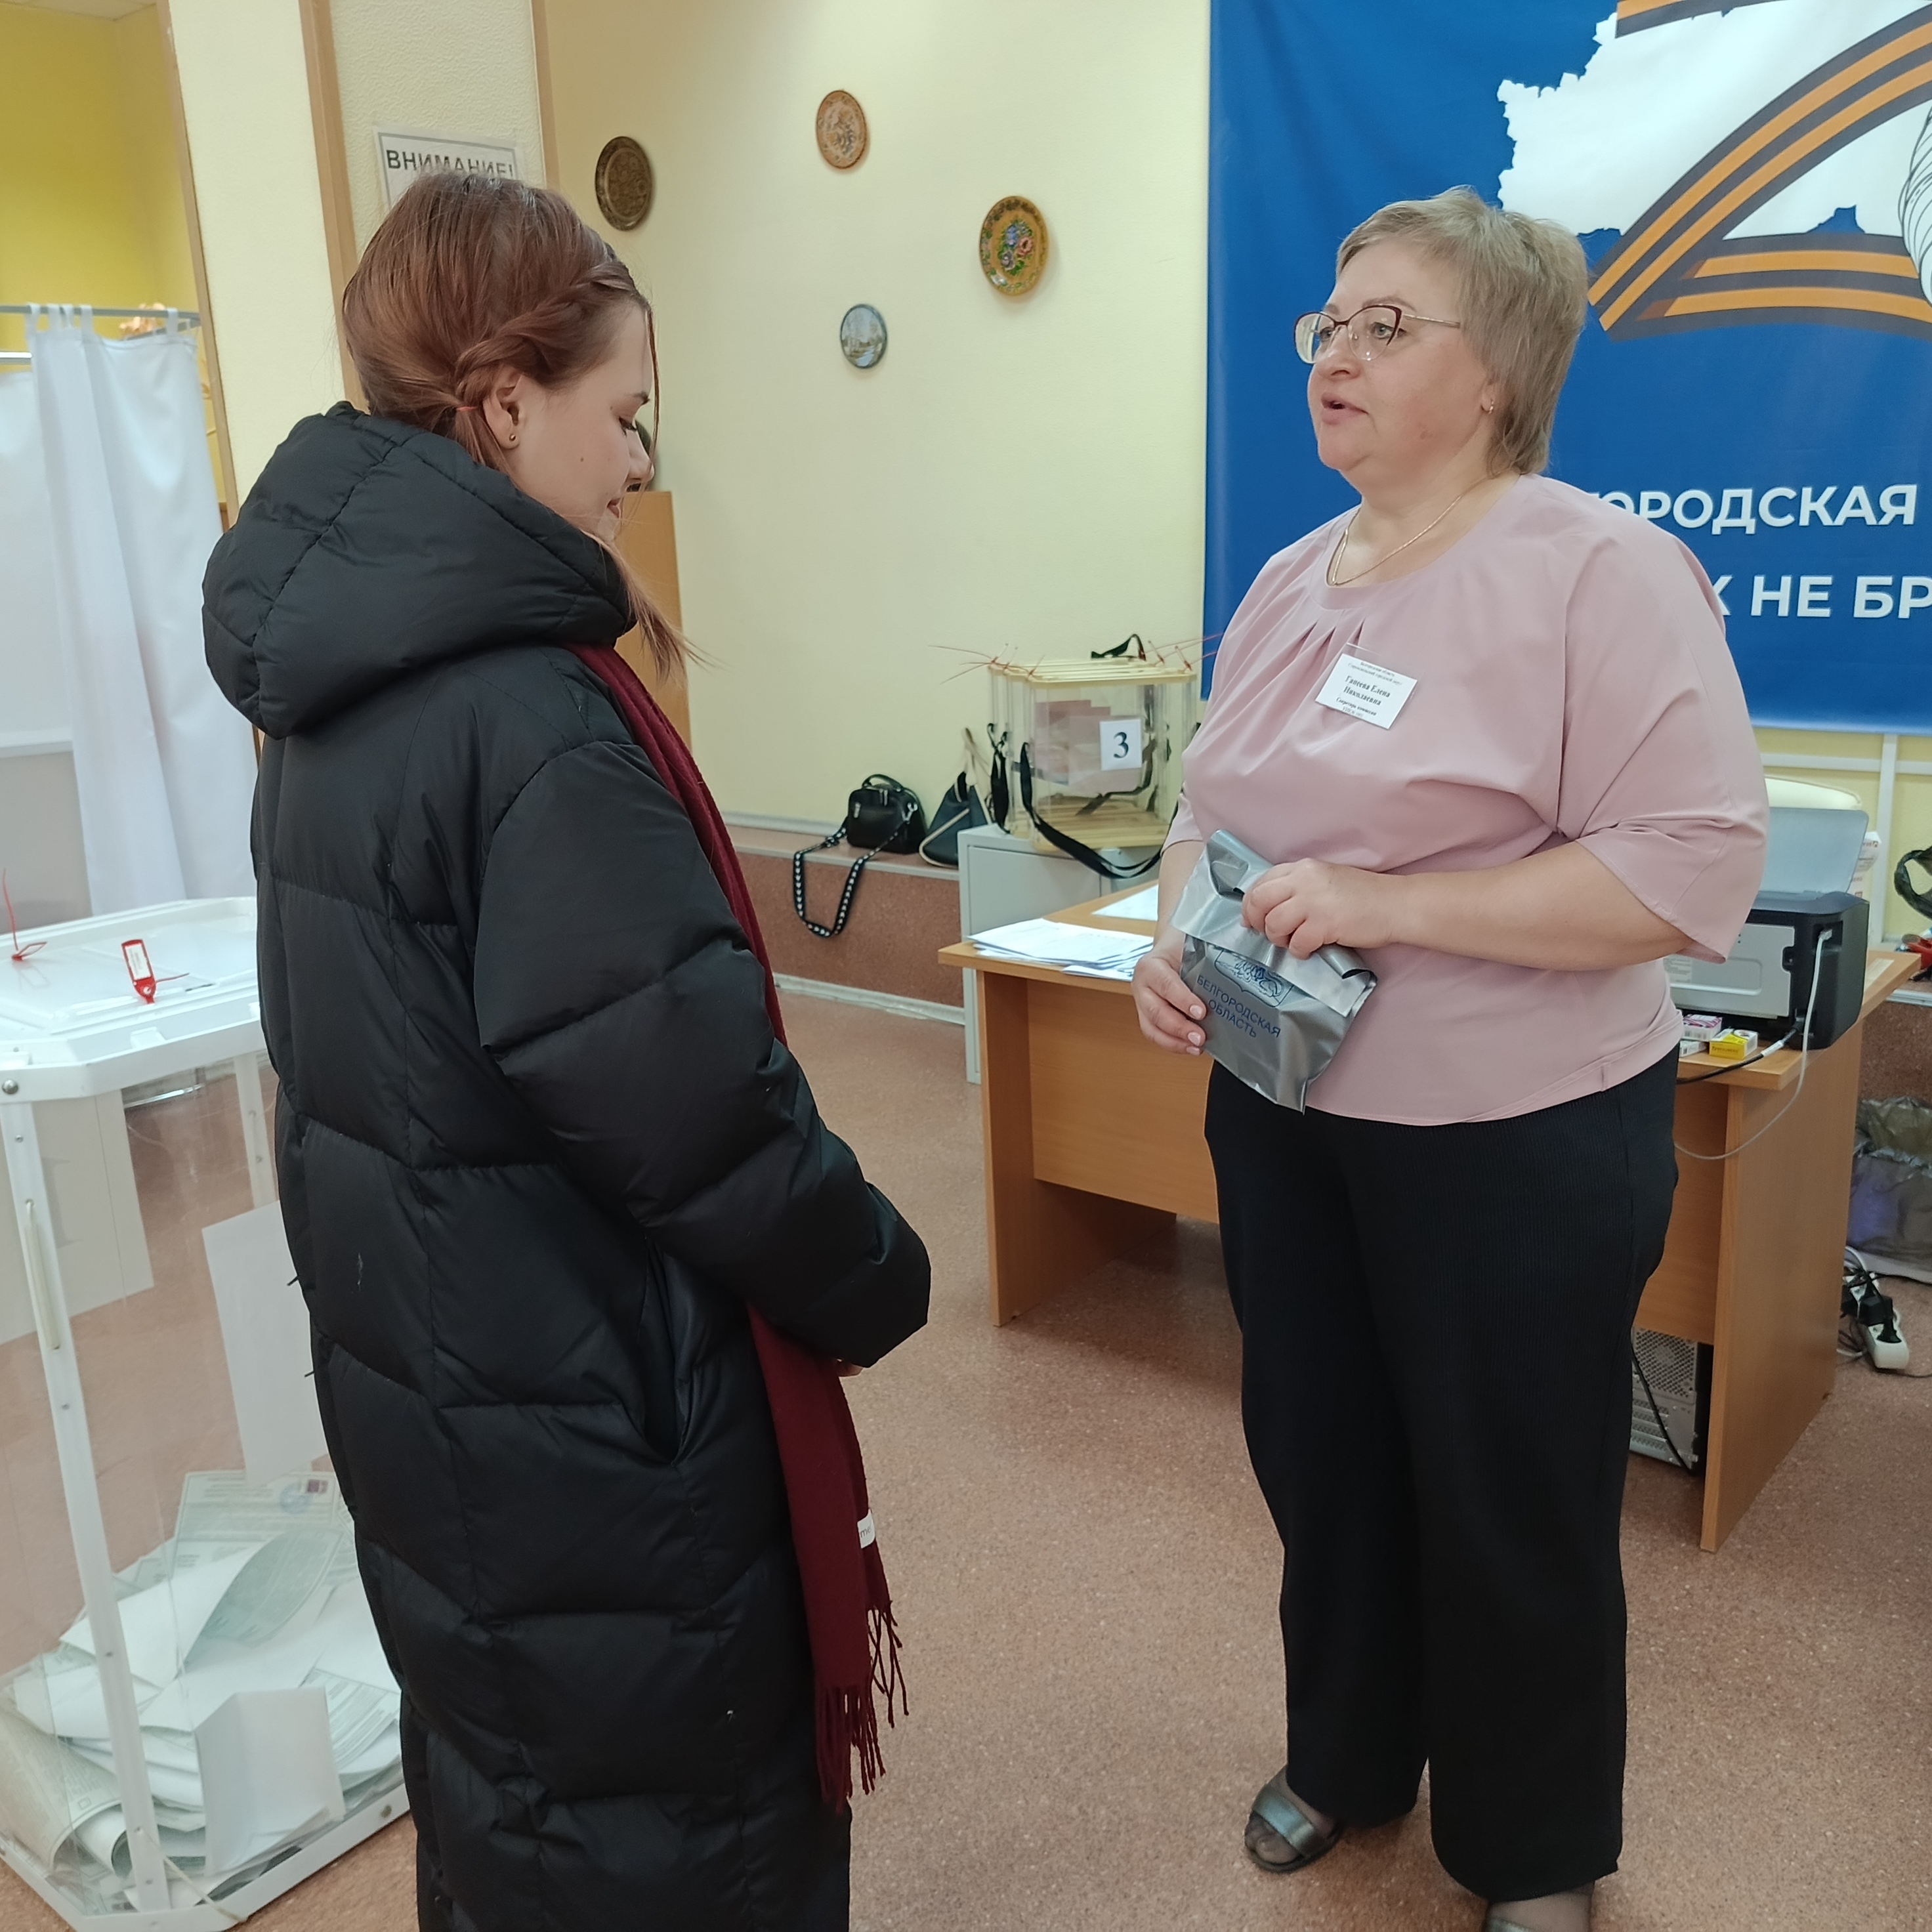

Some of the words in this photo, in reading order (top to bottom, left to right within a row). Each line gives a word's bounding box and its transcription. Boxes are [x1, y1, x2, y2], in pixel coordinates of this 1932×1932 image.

[386, 150, 513, 178] ВНИМАНИЕ!
[1587, 484, 1918, 535] РОДСКАЯ
[1751, 575, 1833, 618] НЕ
[1853, 575, 1932, 619] БР
[1343, 686, 1381, 705] Николаевна
[1370, 684, 1391, 698] Елена
[1114, 732, 1129, 759] 3
[1196, 975, 1281, 1038] БЕЛГОРОДСКАЯ
[1208, 999, 1257, 1038] ОБЛАСТЬ
